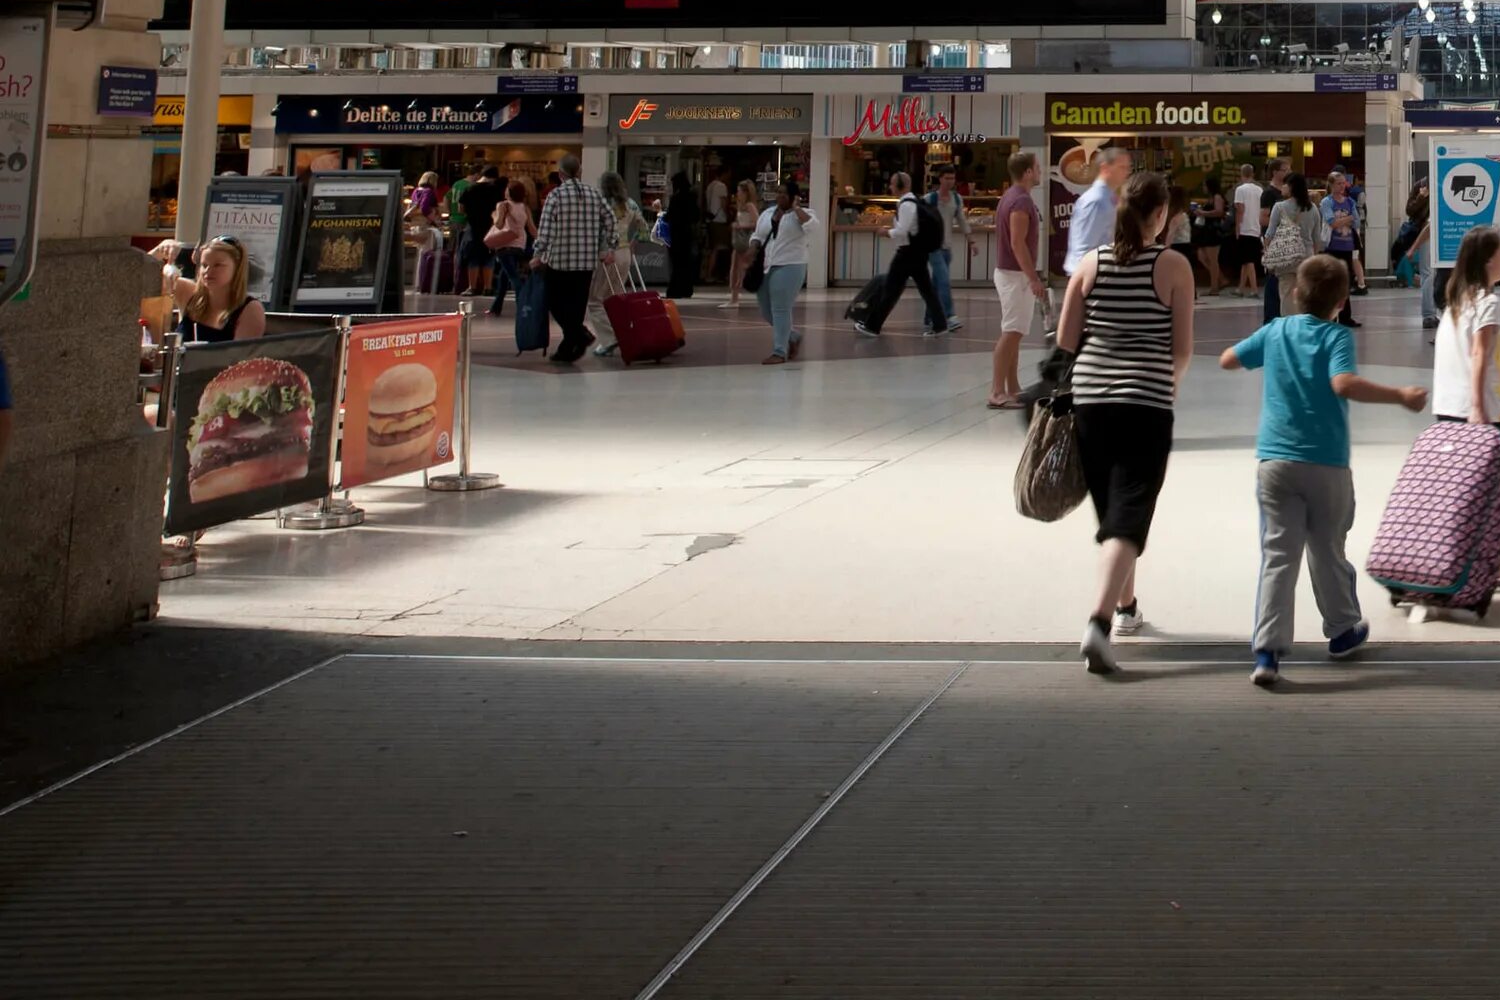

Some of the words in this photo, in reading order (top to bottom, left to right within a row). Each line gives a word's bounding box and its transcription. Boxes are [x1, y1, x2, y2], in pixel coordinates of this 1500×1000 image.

[153, 104, 184, 117] rus
[347, 107, 401, 123] Delice
[406, 107, 426, 123] de
[431, 107, 488, 123] France
[665, 106, 743, 120] JOURNEYS
[750, 106, 803, 120] FRIEND
[1051, 101, 1153, 125] Camden
[1155, 101, 1209, 125] food
[1212, 106, 1247, 125] co.
[842, 96, 951, 146] Millie's
[919, 133, 987, 144] COOKIES
[1183, 140, 1233, 173] right
[214, 211, 280, 226] TITANIC
[310, 218, 382, 229] AFGHANISTAN
[363, 333, 418, 351] BREAKFAST
[418, 330, 443, 344] MENU
[402, 348, 416, 356] 11am
